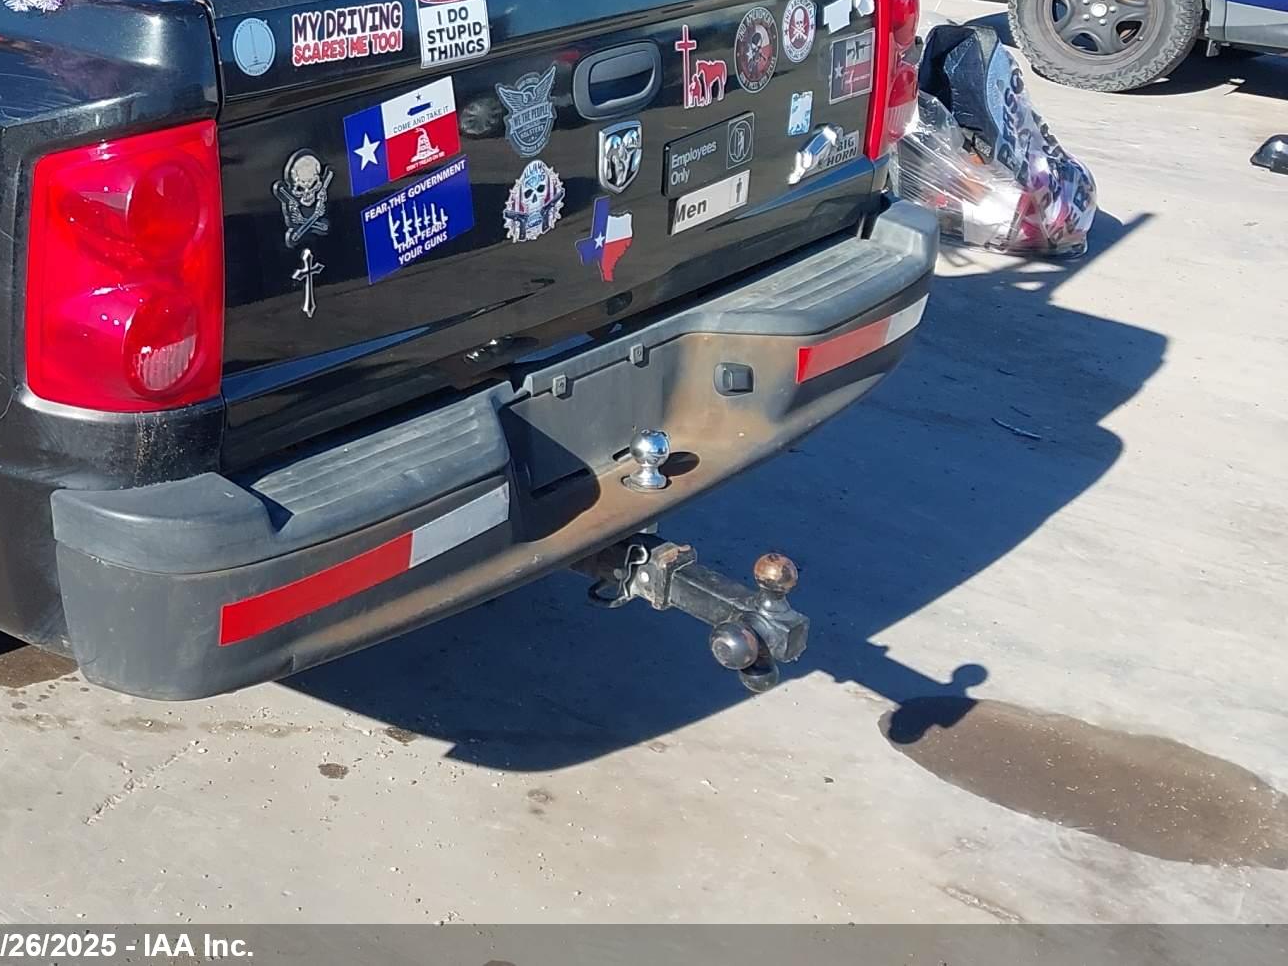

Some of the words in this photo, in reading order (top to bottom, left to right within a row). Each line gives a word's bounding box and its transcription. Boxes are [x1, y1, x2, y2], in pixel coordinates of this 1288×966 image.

[293, 13, 321, 44] MY
[325, 3, 402, 38] DRIVING
[437, 10, 442, 25] I
[447, 6, 469, 23] DO
[427, 21, 482, 45] STUPID
[293, 37, 346, 65] SCARES
[349, 35, 368, 56] ME
[371, 30, 402, 54] TOO!
[428, 38, 485, 62] THINGS
[393, 121, 411, 134] COME
[413, 116, 426, 125] AND
[426, 109, 443, 121] TAKE
[443, 105, 449, 114] IT
[672, 141, 717, 169] Employees
[826, 146, 857, 167] HORN
[837, 137, 855, 151] BIG
[671, 167, 690, 186] Only
[365, 203, 389, 222] FEAR
[388, 192, 407, 209] THE
[407, 159, 466, 198] GOVERNMENT
[675, 199, 707, 224] Men
[397, 235, 419, 254] THAT
[420, 221, 447, 240] FEARS
[398, 246, 423, 265] YOUR
[424, 231, 448, 251] GUNS
